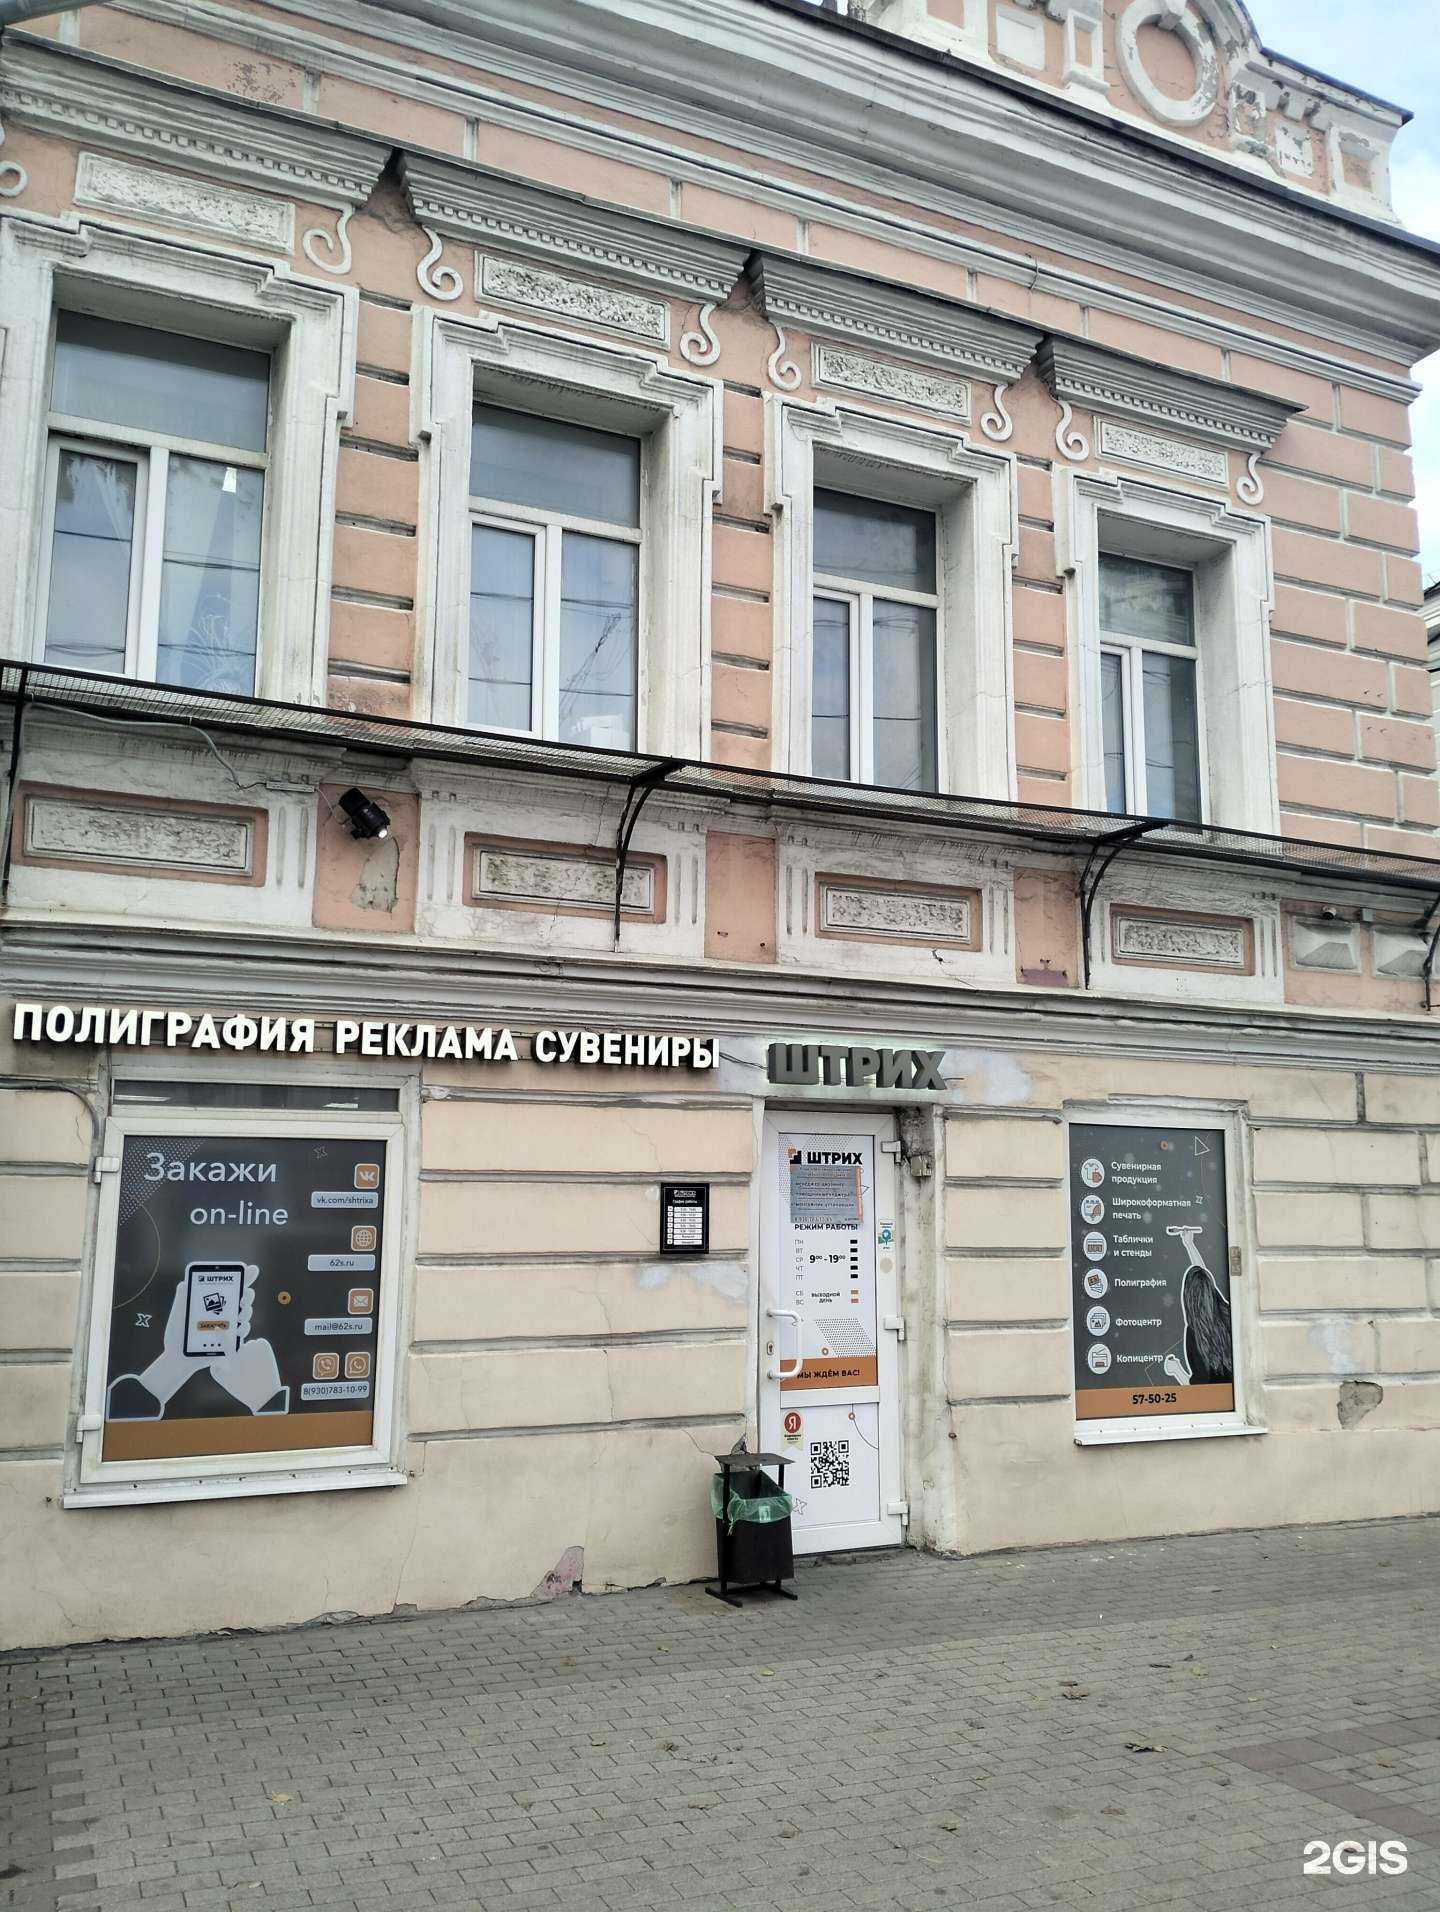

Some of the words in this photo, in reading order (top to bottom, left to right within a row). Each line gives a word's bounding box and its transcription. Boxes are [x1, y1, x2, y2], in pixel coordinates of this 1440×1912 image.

[12, 1003, 316, 1054] ПОЛИГРАФИЯ
[335, 1023, 518, 1062] РЕКЛАМА
[533, 1029, 720, 1069] СУВЕНИРЫ
[768, 1043, 947, 1090] ШТРИХ
[807, 1151, 863, 1165] ШТРИХ
[144, 1153, 278, 1182] Закажи
[1111, 1161, 1162, 1172] Сувенирная
[1111, 1176, 1158, 1185] продукция
[1112, 1197, 1191, 1208] Широкоформатная
[190, 1201, 289, 1225] on-line
[794, 1223, 824, 1231] РЕЖИМ
[825, 1223, 858, 1231] РАБОТЫ
[1113, 1234, 1154, 1243] Таблички
[1121, 1249, 1152, 1257] стенды
[329, 1258, 354, 1267] 62s.ru
[1114, 1278, 1167, 1288] Полиграфия
[314, 1322, 363, 1332] mail@62s.ru
[1115, 1318, 1162, 1327] Фотоцентр
[1116, 1354, 1164, 1363] Копицентр
[841, 1369, 860, 1377] ВАС!
[303, 1385, 368, 1396] 8(930)783-10-99
[1132, 1393, 1177, 1405] 57-50-25
